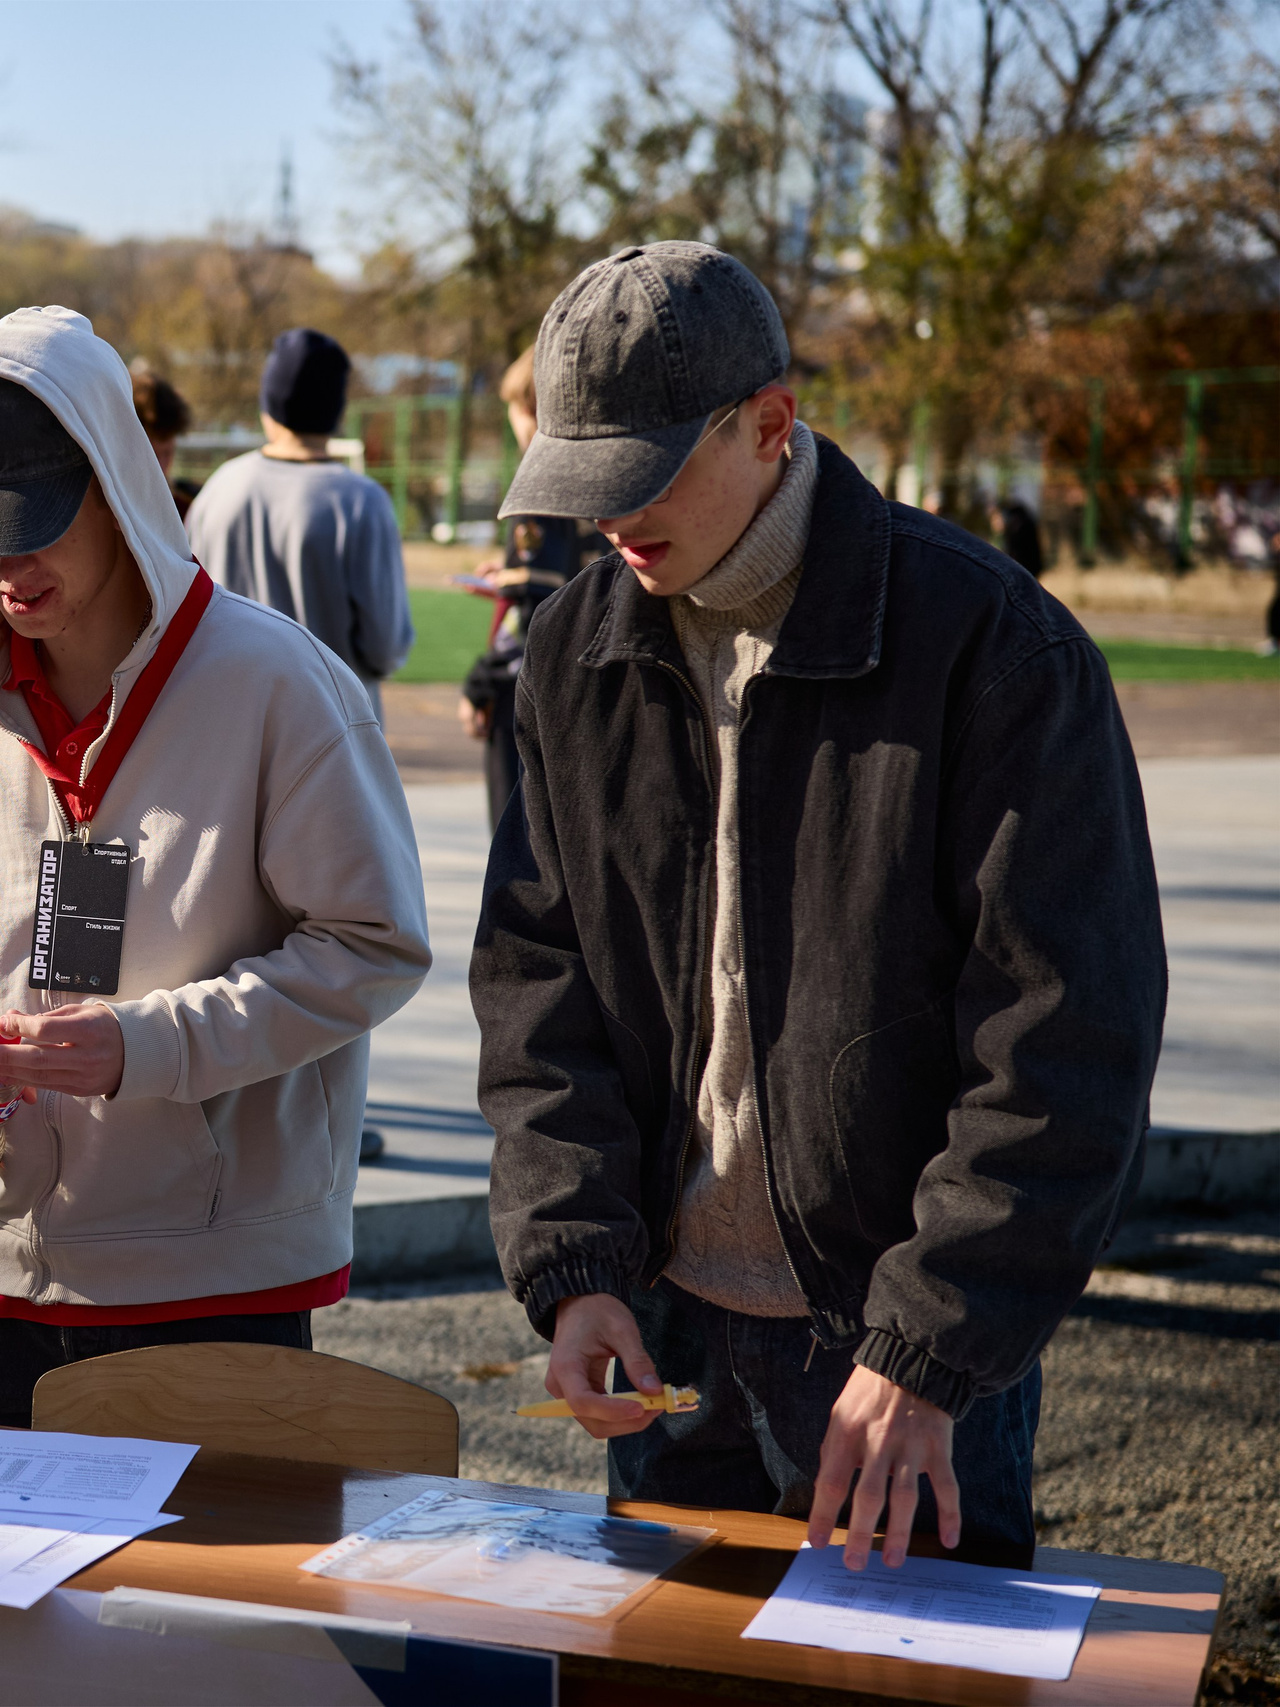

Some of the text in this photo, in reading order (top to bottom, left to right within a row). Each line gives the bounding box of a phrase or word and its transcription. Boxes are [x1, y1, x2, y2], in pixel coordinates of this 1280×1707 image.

[93, 848, 128, 857] Спортивный
[32, 849, 59, 981] ОРГАНИЗАТОР
[85, 922, 102, 930] Стиль
